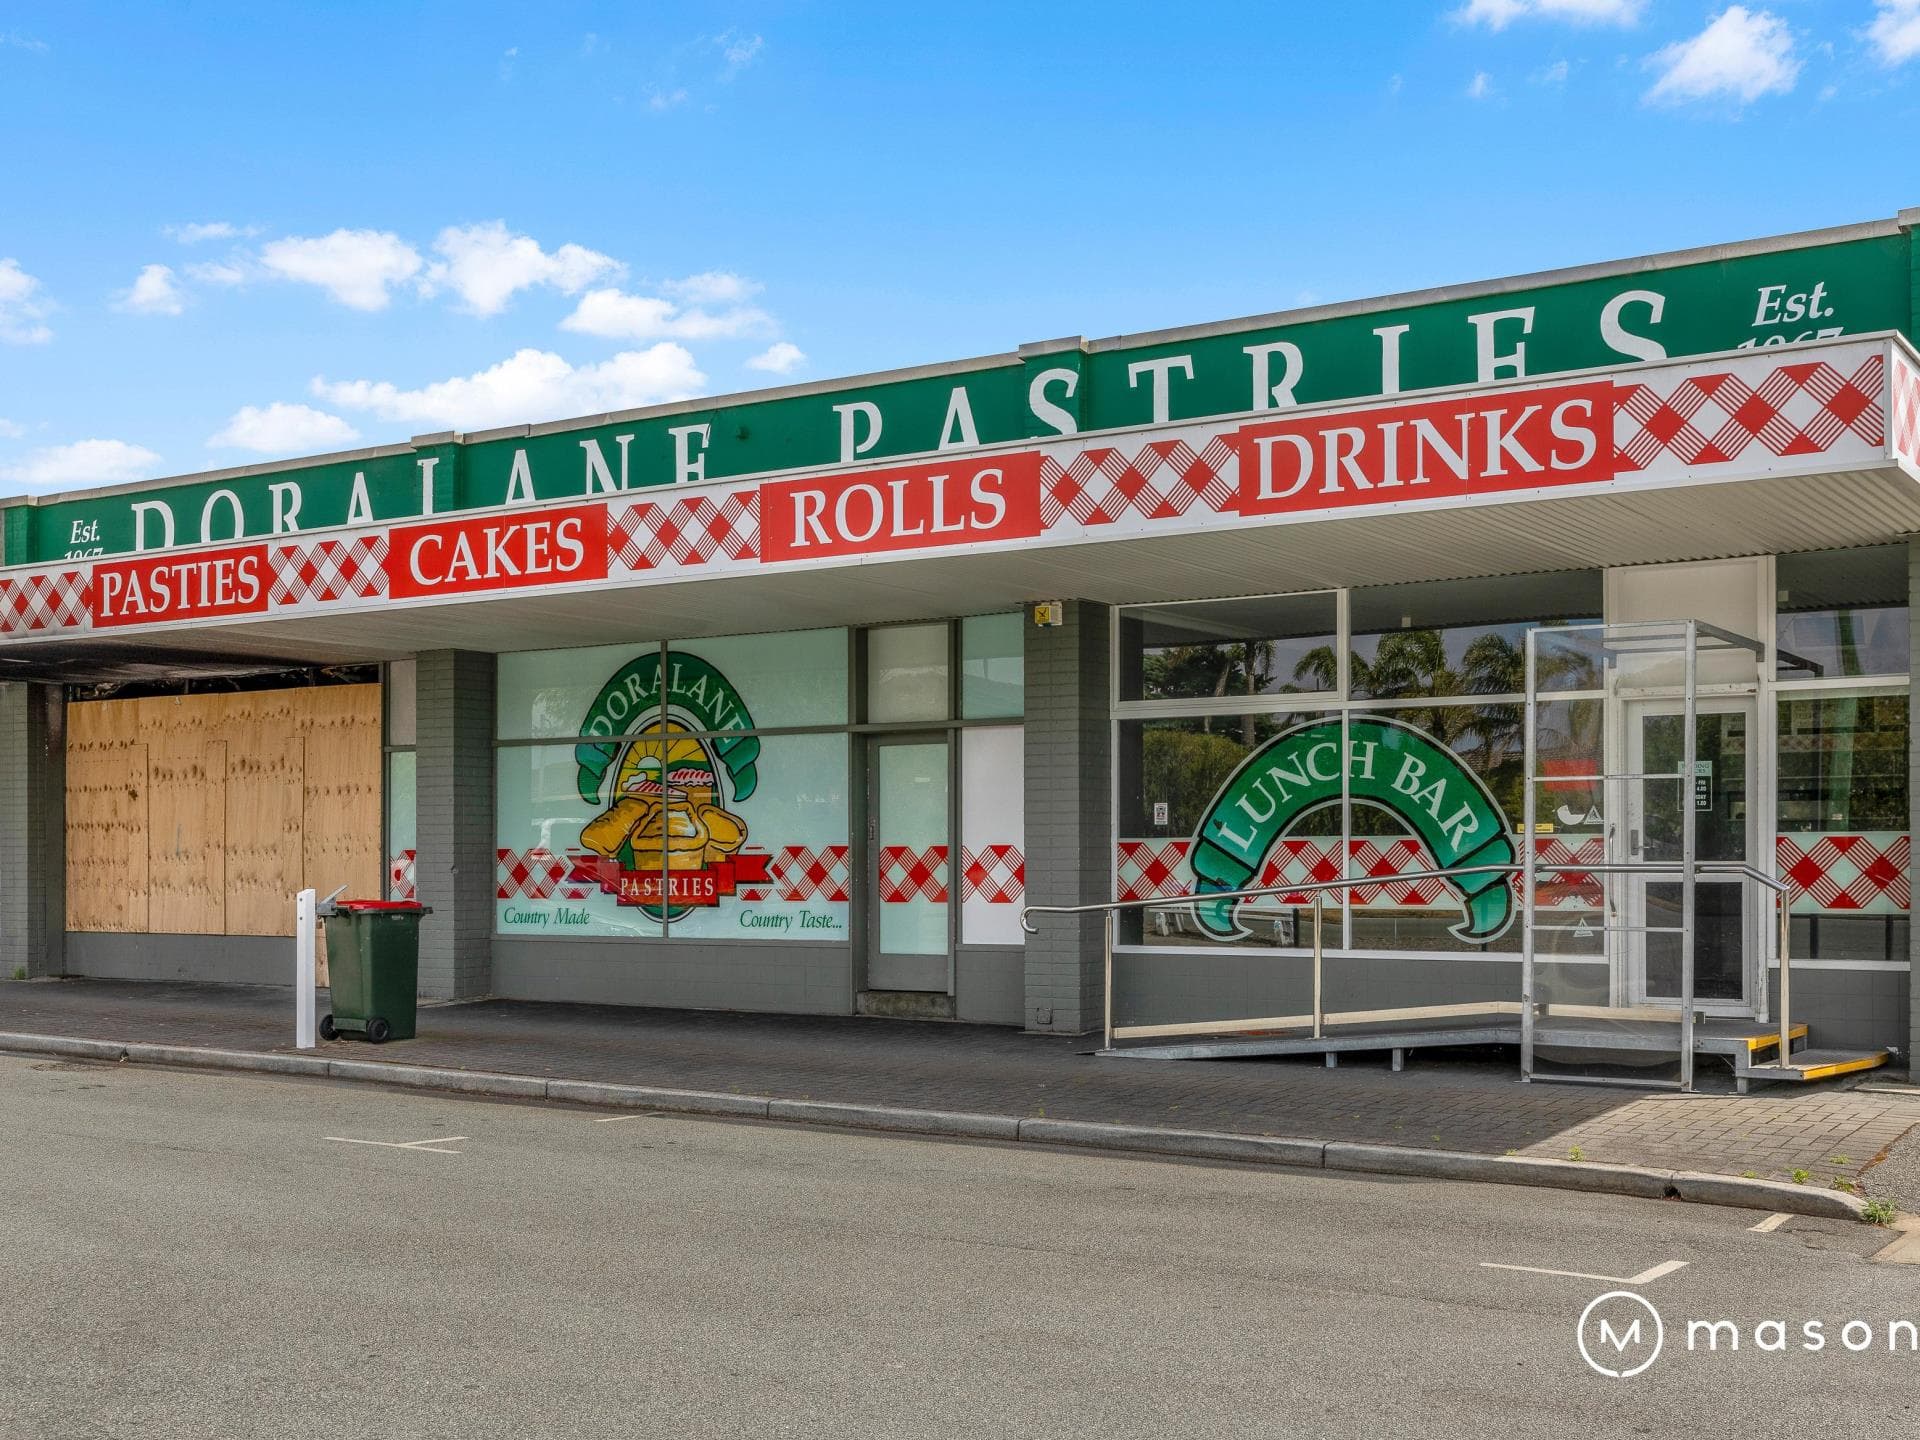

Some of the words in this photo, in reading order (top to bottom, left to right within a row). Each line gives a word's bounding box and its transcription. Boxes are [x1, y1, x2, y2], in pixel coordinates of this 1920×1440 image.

[1751, 281, 1834, 327] Est.
[1253, 399, 1597, 501] DRINKS
[70, 519, 101, 544] Est.
[789, 468, 1006, 548] ROLLS
[409, 517, 585, 586] CAKES
[100, 555, 260, 618] PASTIES
[1217, 740, 1378, 852] LUNCH
[1391, 752, 1480, 852] BAR
[620, 877, 714, 897] PASTRIES
[504, 907, 550, 926] Country
[553, 907, 591, 926] Made
[740, 909, 793, 932] Country
